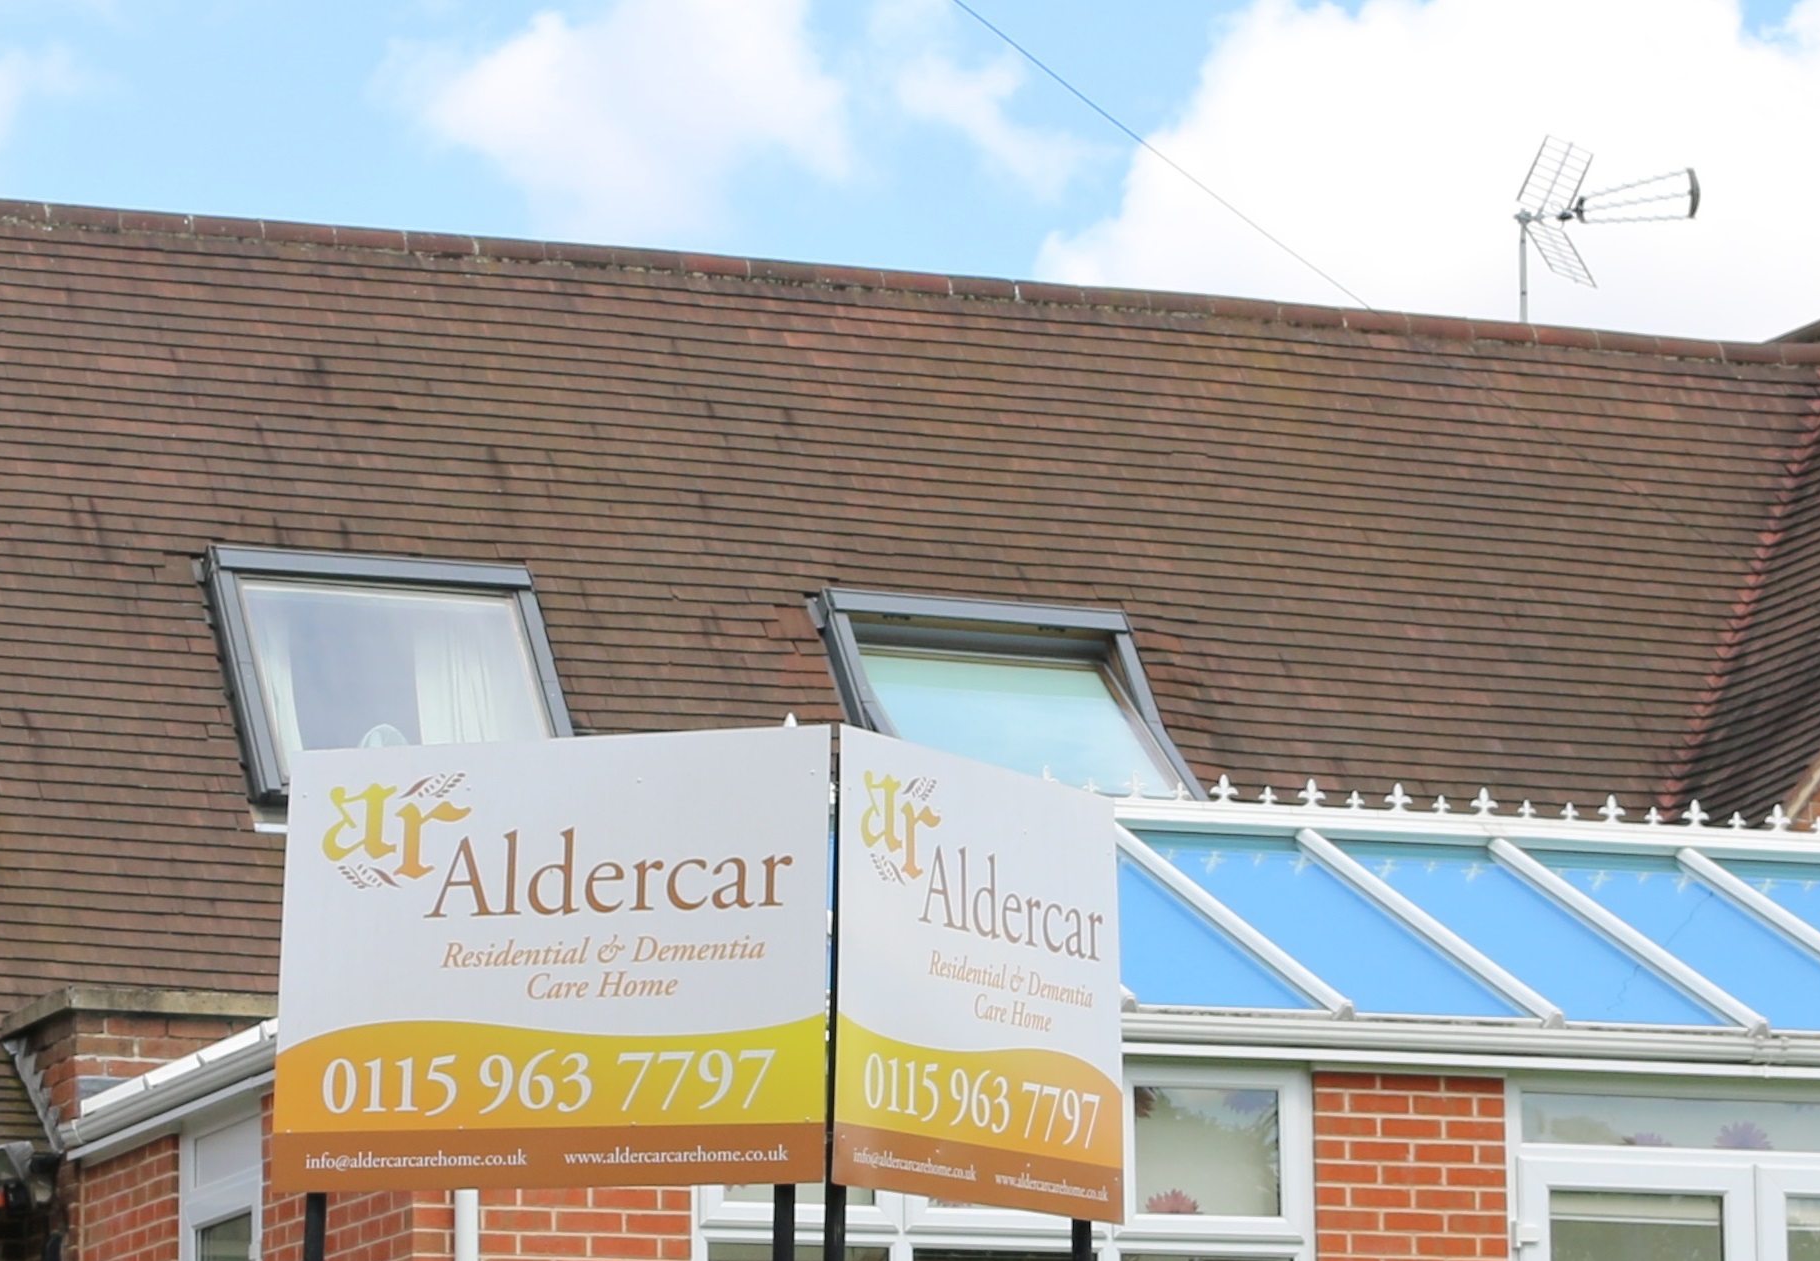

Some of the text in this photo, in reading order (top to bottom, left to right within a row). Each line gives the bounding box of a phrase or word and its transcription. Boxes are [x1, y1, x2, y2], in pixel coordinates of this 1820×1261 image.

[424, 827, 794, 919] Aldercar
[918, 844, 1103, 962] Aldercar
[441, 935, 766, 970] Residential & Dementia
[526, 971, 678, 1001] Care Home
[928, 949, 1093, 1009] Residential & Dementia
[974, 995, 1052, 1033] Care Home
[322, 1048, 776, 1116] 0115 963 7797
[864, 1052, 1102, 1149] 0115 963 7797
[305, 1148, 527, 1172] info@aldercarcarehome.co.uk
[564, 1144, 788, 1165] www.aldercarcarehome.co.uk
[852, 1147, 977, 1182] info@aldercarcarehome.co.uk
[995, 1171, 1109, 1202] www.aldercarcarehome.co.uk
